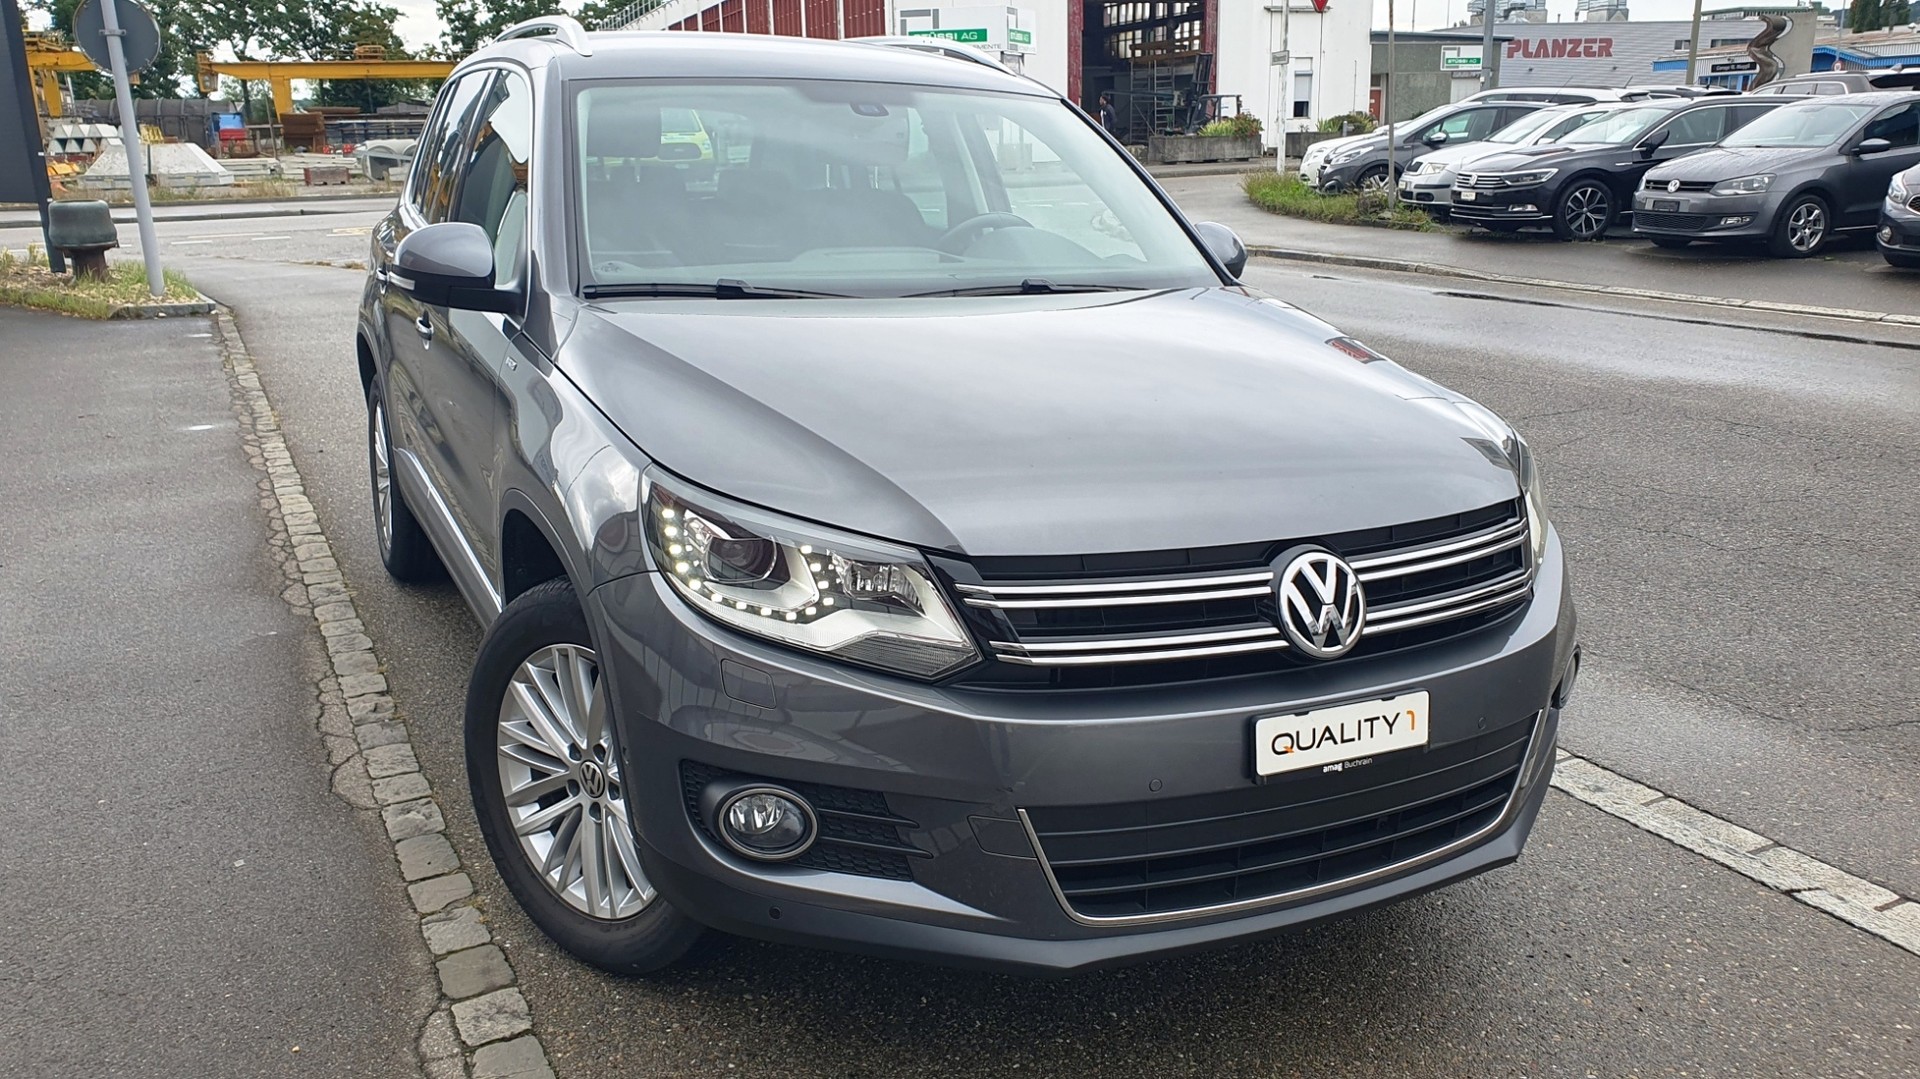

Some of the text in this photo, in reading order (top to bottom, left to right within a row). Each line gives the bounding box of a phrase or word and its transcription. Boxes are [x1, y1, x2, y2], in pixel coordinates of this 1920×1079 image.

[960, 31, 978, 41] AG
[1507, 37, 1614, 59] PLANZER
[1280, 551, 1364, 653] VW
[1271, 712, 1401, 756] QUALITY
[1322, 757, 1373, 773] amag Buchrain
